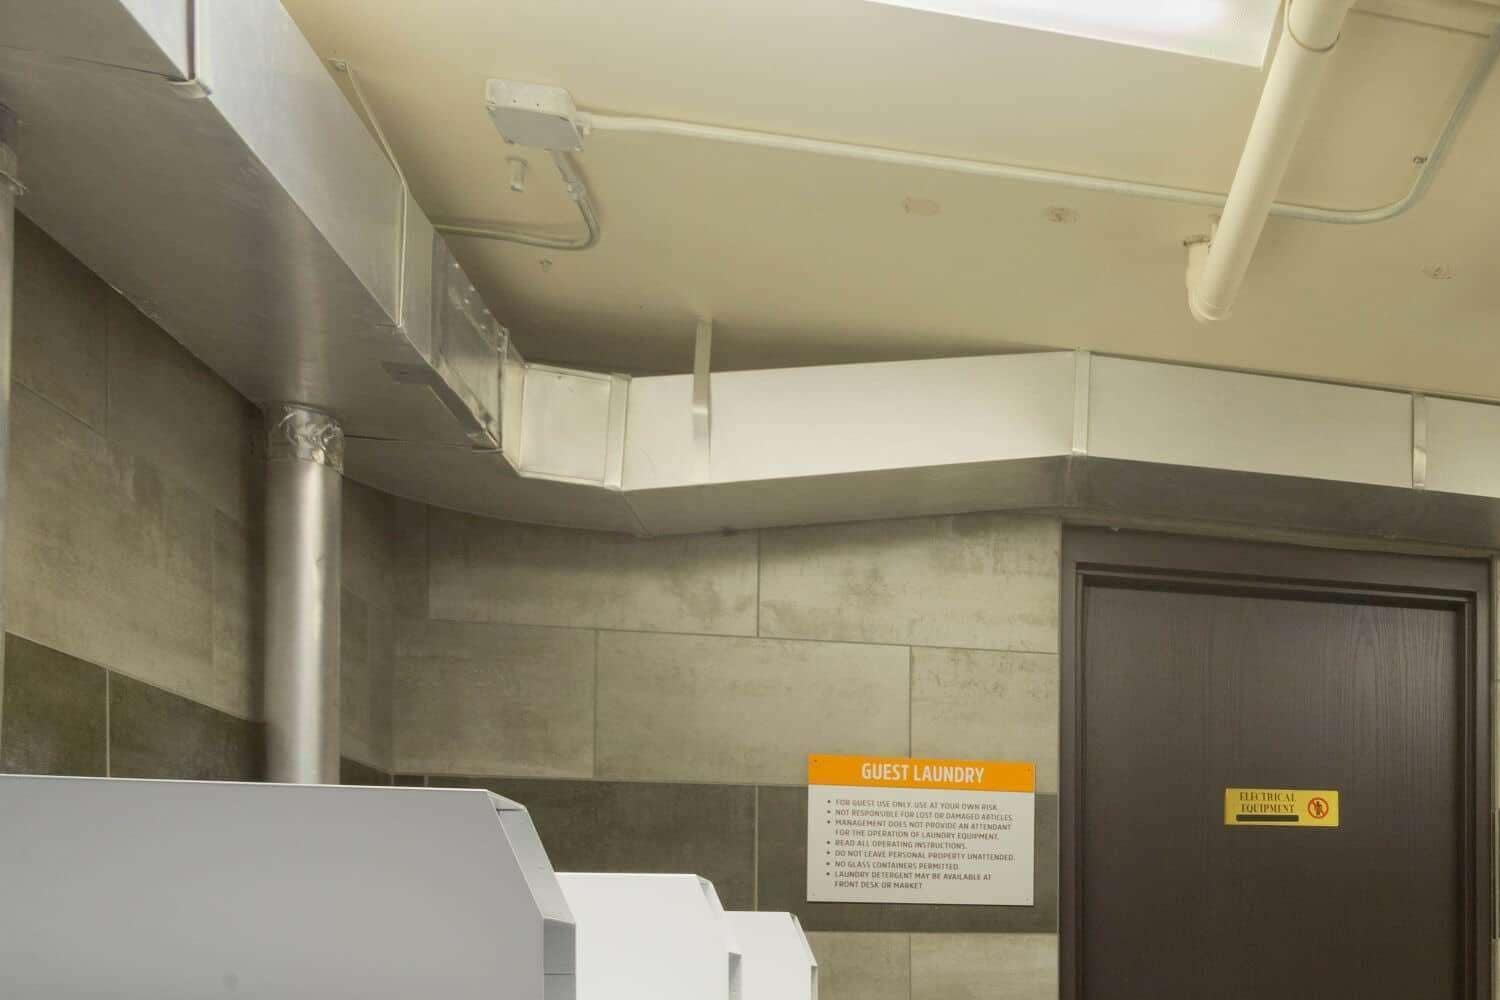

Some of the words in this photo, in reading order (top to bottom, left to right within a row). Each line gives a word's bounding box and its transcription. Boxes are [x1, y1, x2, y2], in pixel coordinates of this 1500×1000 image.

[861, 762, 910, 782] GUEST
[914, 764, 985, 783] LAUNDRY
[1239, 791, 1297, 802] ELECTRICAL
[852, 799, 876, 807] GUEST
[914, 801, 927, 809] USE
[940, 802, 960, 810] YOUR
[961, 802, 980, 810] OWN
[1241, 803, 1295, 814] EQUIPMENT
[851, 809, 899, 817] RESPONSIBLE
[900, 810, 915, 818] FOR
[916, 811, 933, 819] LOST
[945, 812, 980, 821] DAMAGED
[835, 819, 887, 827] MANAGEMENT
[888, 820, 908, 828] DOES
[925, 821, 957, 830] PROVIDE
[958, 822, 969, 830] AN
[970, 822, 1012, 831] ATTENDANT
[852, 829, 866, 837] THE
[867, 830, 909, 838] OPERATION
[921, 831, 955, 840] LAUNDRY
[834, 839, 855, 847] READ
[872, 840, 913, 848] OPERATING
[864, 850, 886, 858] LEAVE
[888, 851, 926, 859] PERSONAL
[927, 852, 966, 860] PROPERTY
[872, 861, 918, 869] CONTAINERS
[871, 871, 913, 879] DETERGENT
[943, 873, 981, 881] AVAILABLE
[983, 873, 992, 881] AT
